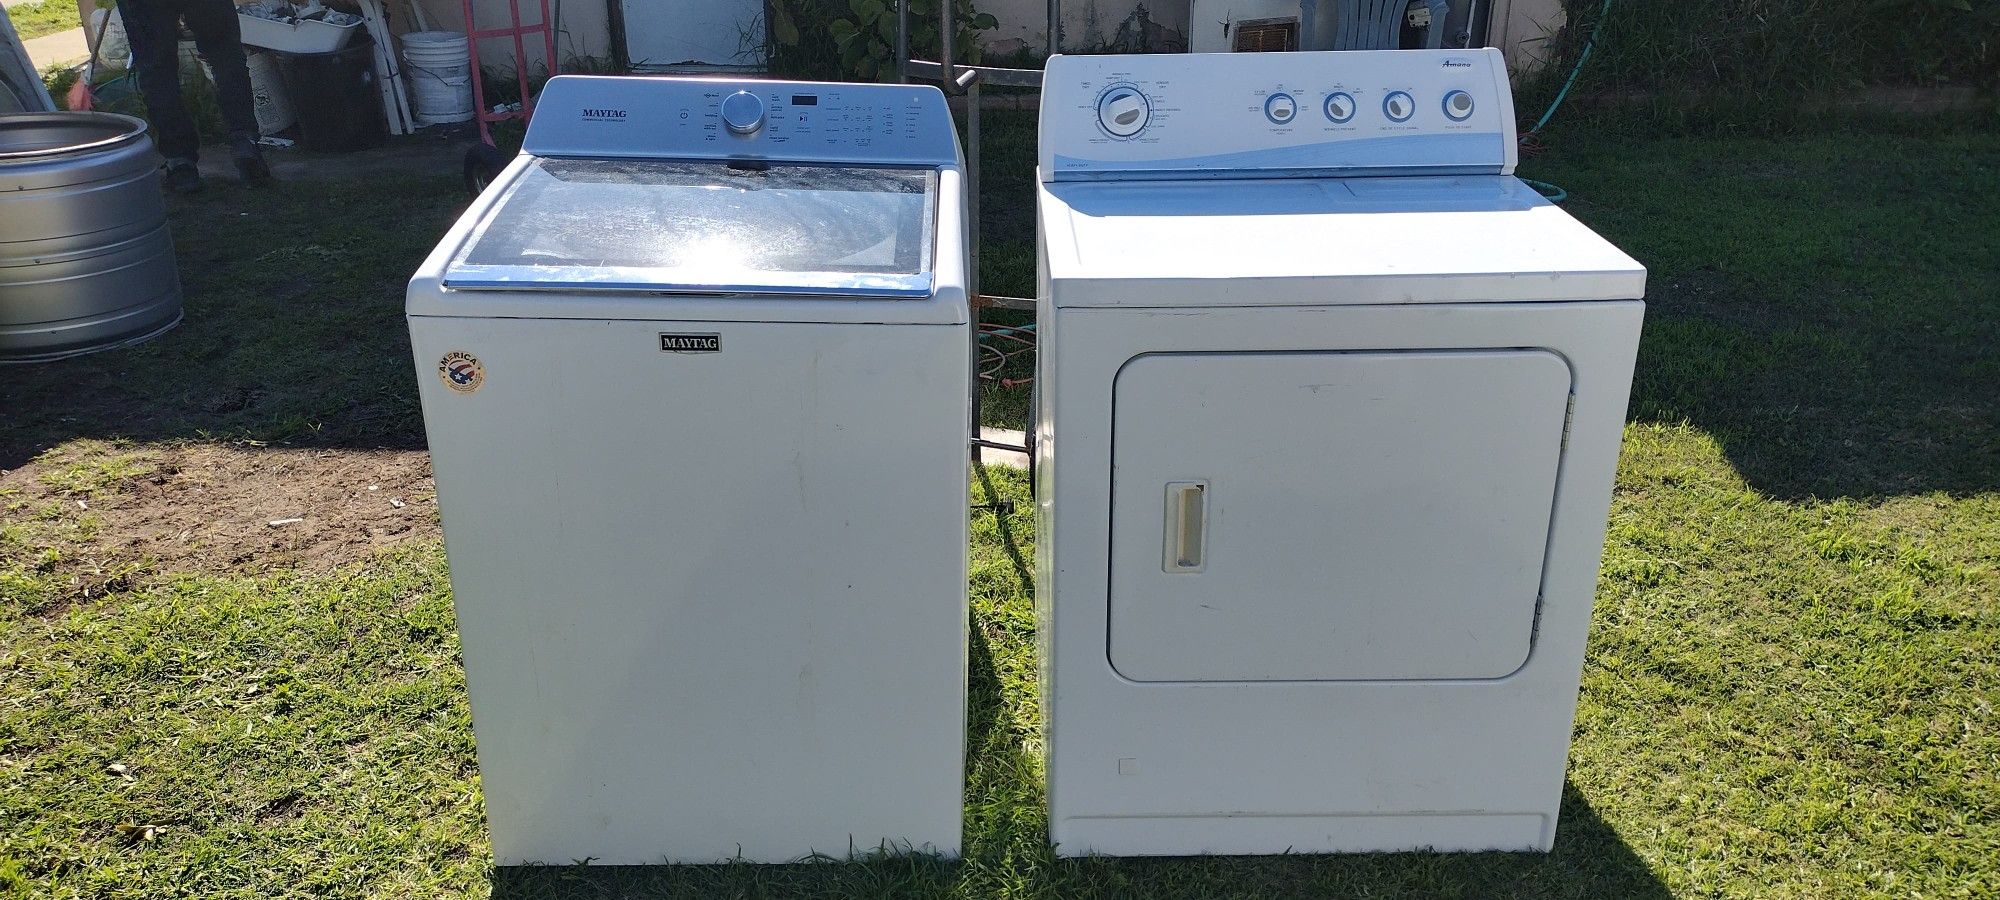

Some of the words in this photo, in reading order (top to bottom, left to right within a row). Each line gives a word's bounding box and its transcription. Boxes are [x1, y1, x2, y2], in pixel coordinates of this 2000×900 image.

[1442, 60, 1471, 68] Amana
[582, 109, 627, 118] MAYTAG
[663, 338, 717, 349] MAYTAG
[439, 352, 477, 372] AMERICA
